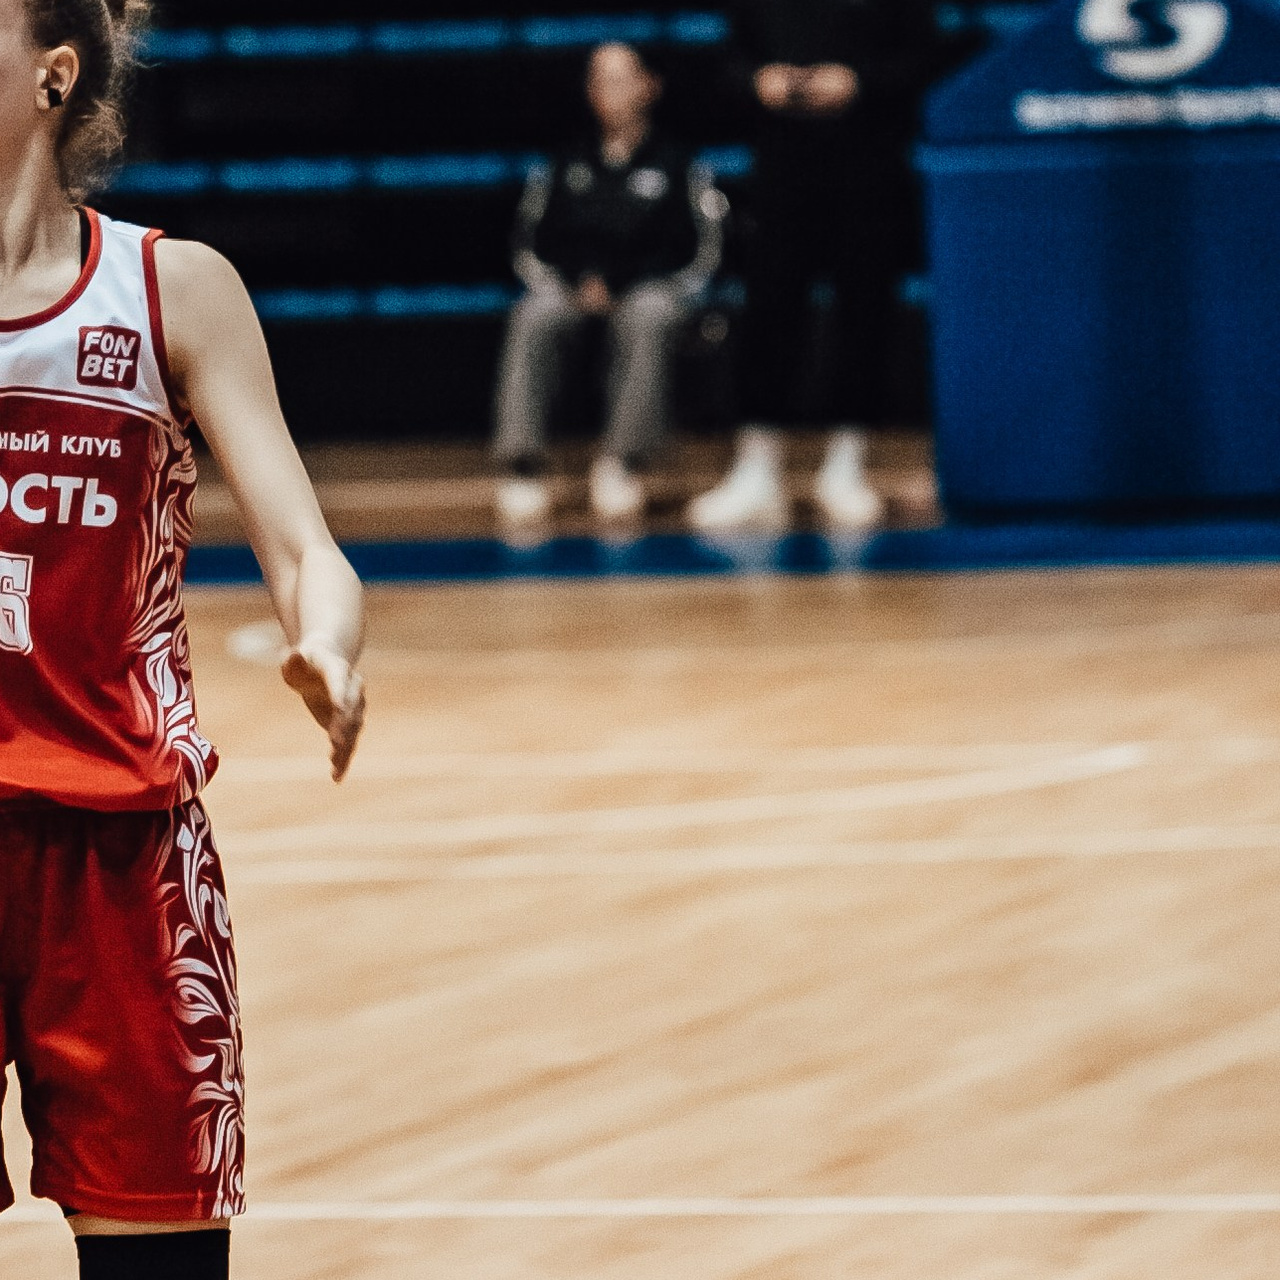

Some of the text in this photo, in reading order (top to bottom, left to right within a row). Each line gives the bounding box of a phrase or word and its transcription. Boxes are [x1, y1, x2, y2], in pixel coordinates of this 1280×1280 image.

[83, 331, 137, 358] FON
[81, 354, 134, 382] BET
[61, 435, 122, 458] КЛУБ
